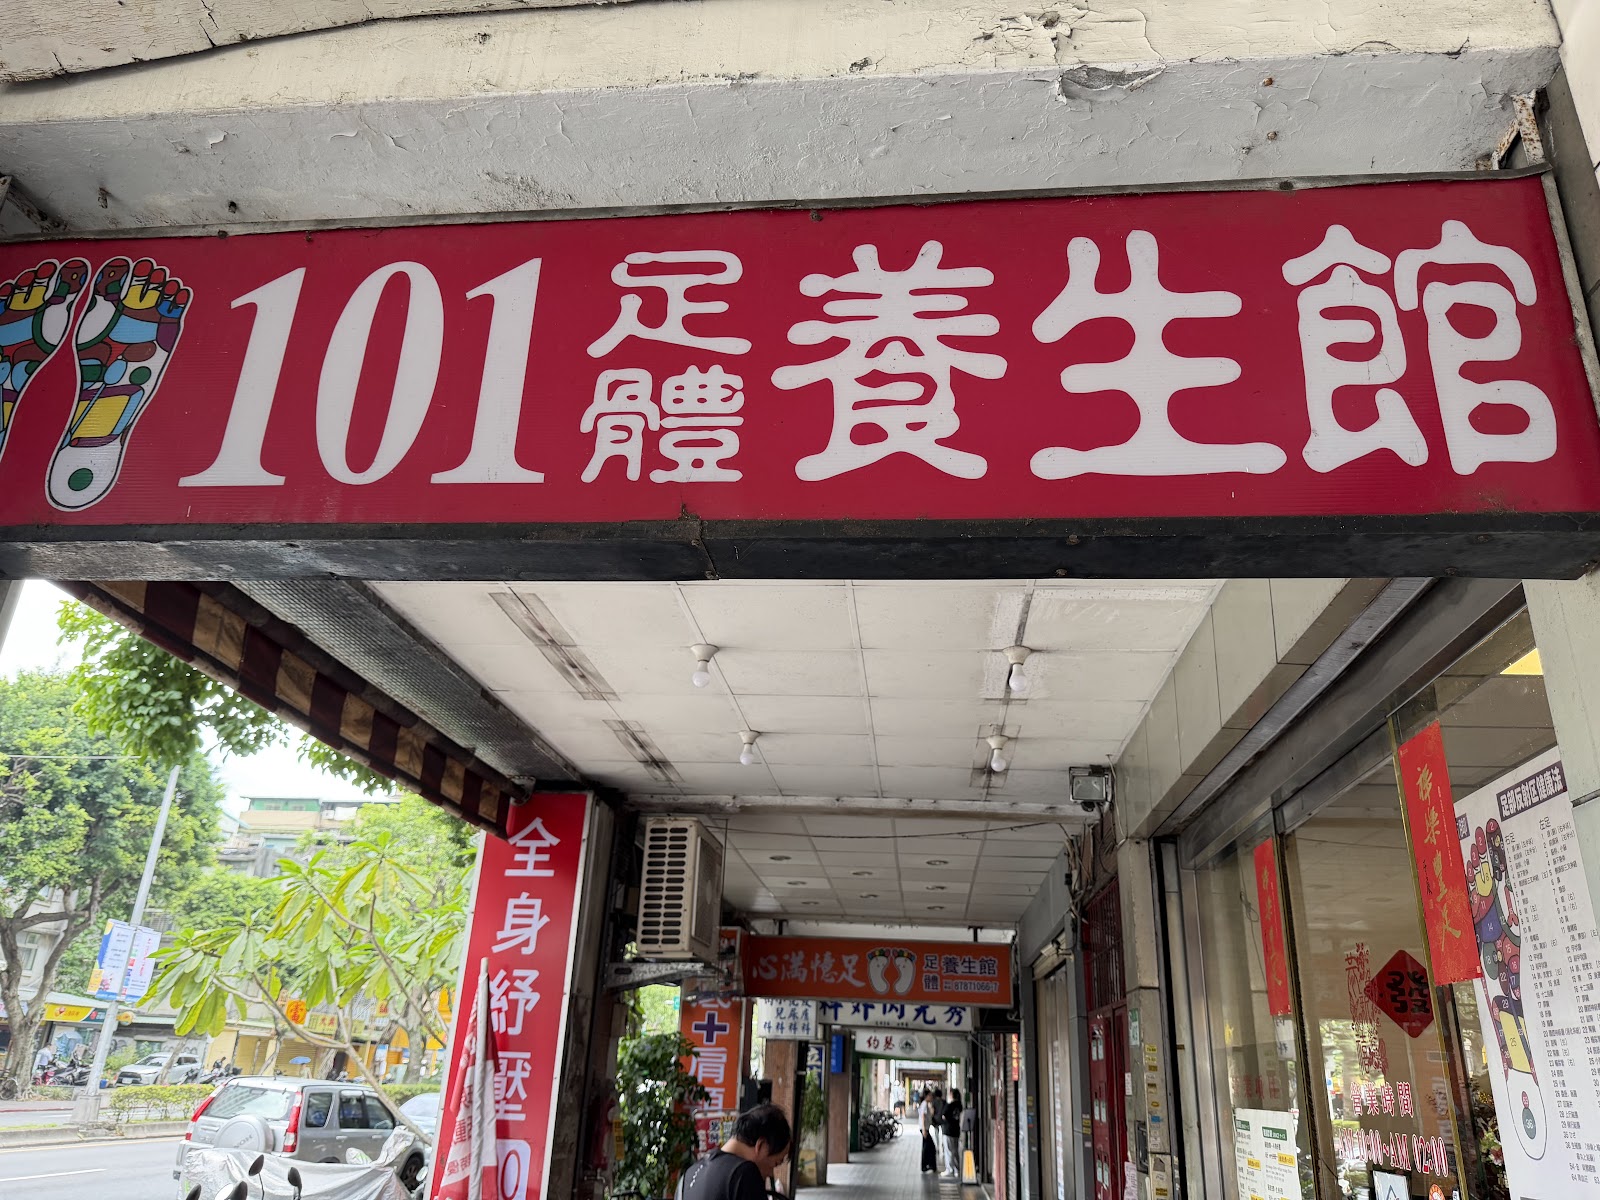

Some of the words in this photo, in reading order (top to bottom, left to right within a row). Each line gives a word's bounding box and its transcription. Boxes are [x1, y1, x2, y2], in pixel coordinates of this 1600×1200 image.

[178, 257, 545, 488] 101
[770, 218, 1558, 482] 養生館
[942, 956, 998, 977] 養生館
[1350, 1081, 1414, 1118] 營業時間
